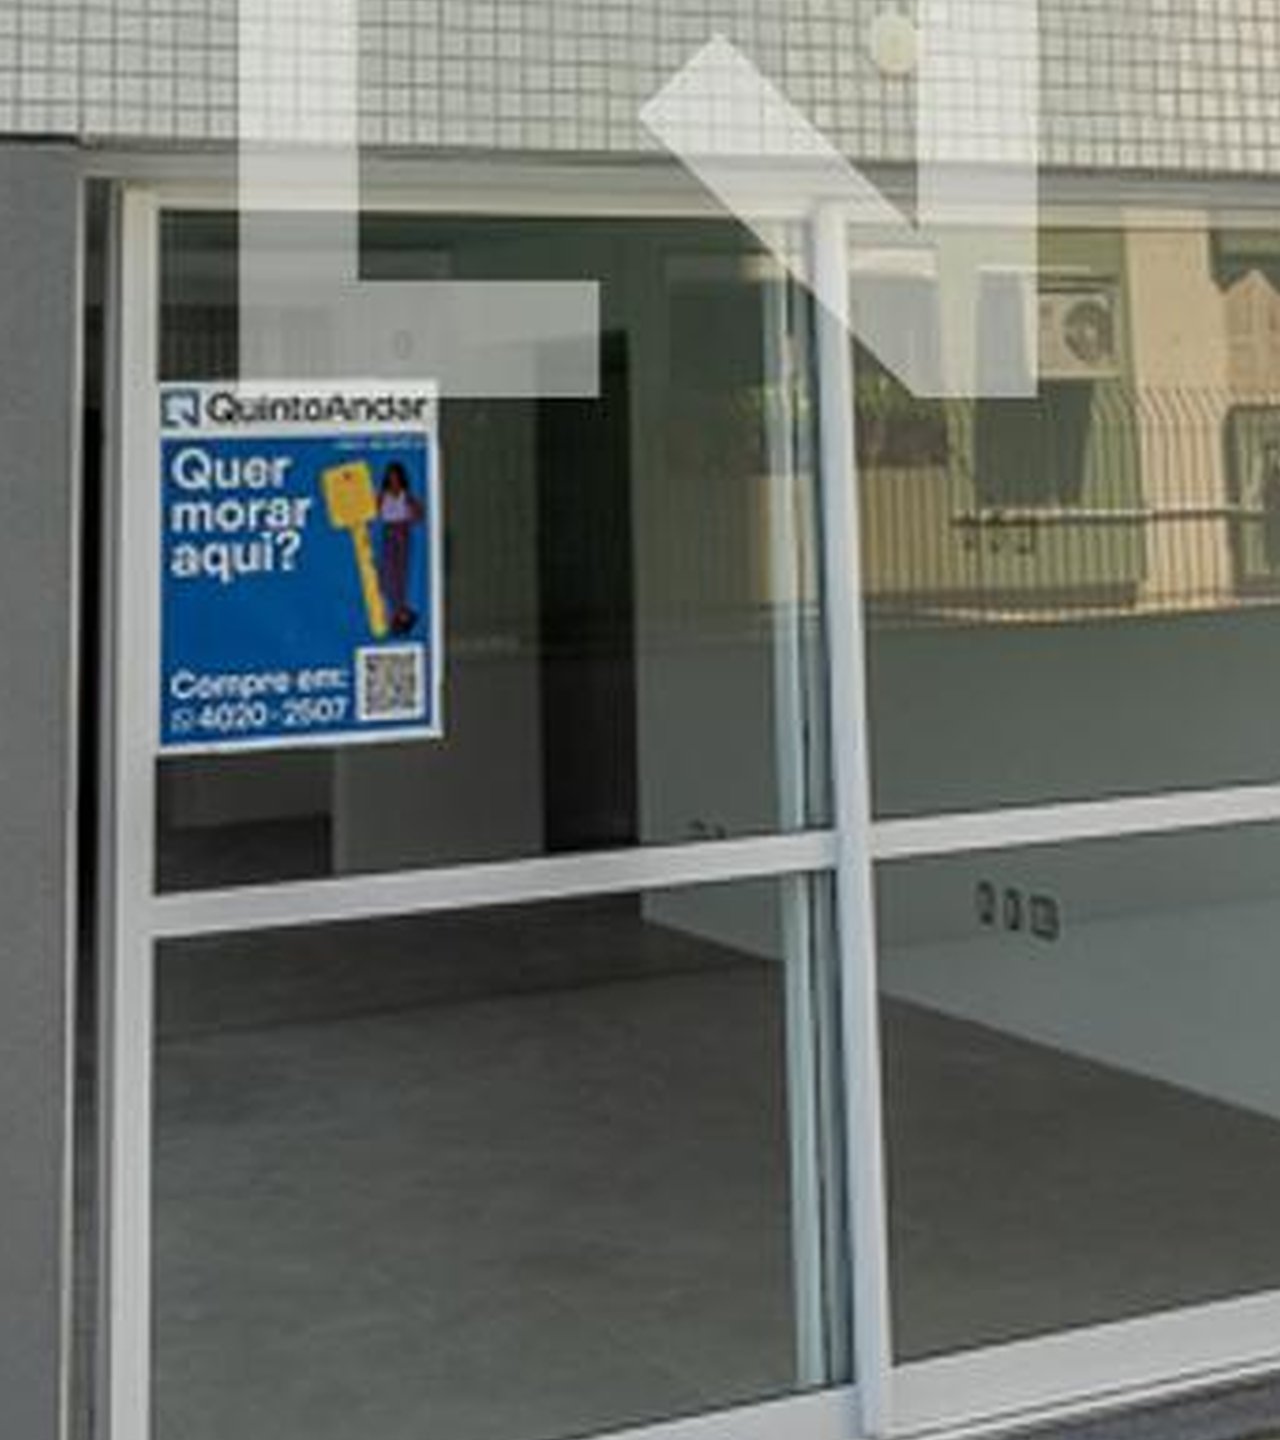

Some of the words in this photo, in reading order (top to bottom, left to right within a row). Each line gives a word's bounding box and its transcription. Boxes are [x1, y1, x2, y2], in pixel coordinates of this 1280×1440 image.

[206, 392, 428, 423] QuintoAndar
[171, 448, 292, 492] Quer
[171, 497, 312, 533] morar
[171, 530, 301, 583] aqui?
[170, 670, 289, 699] Compre
